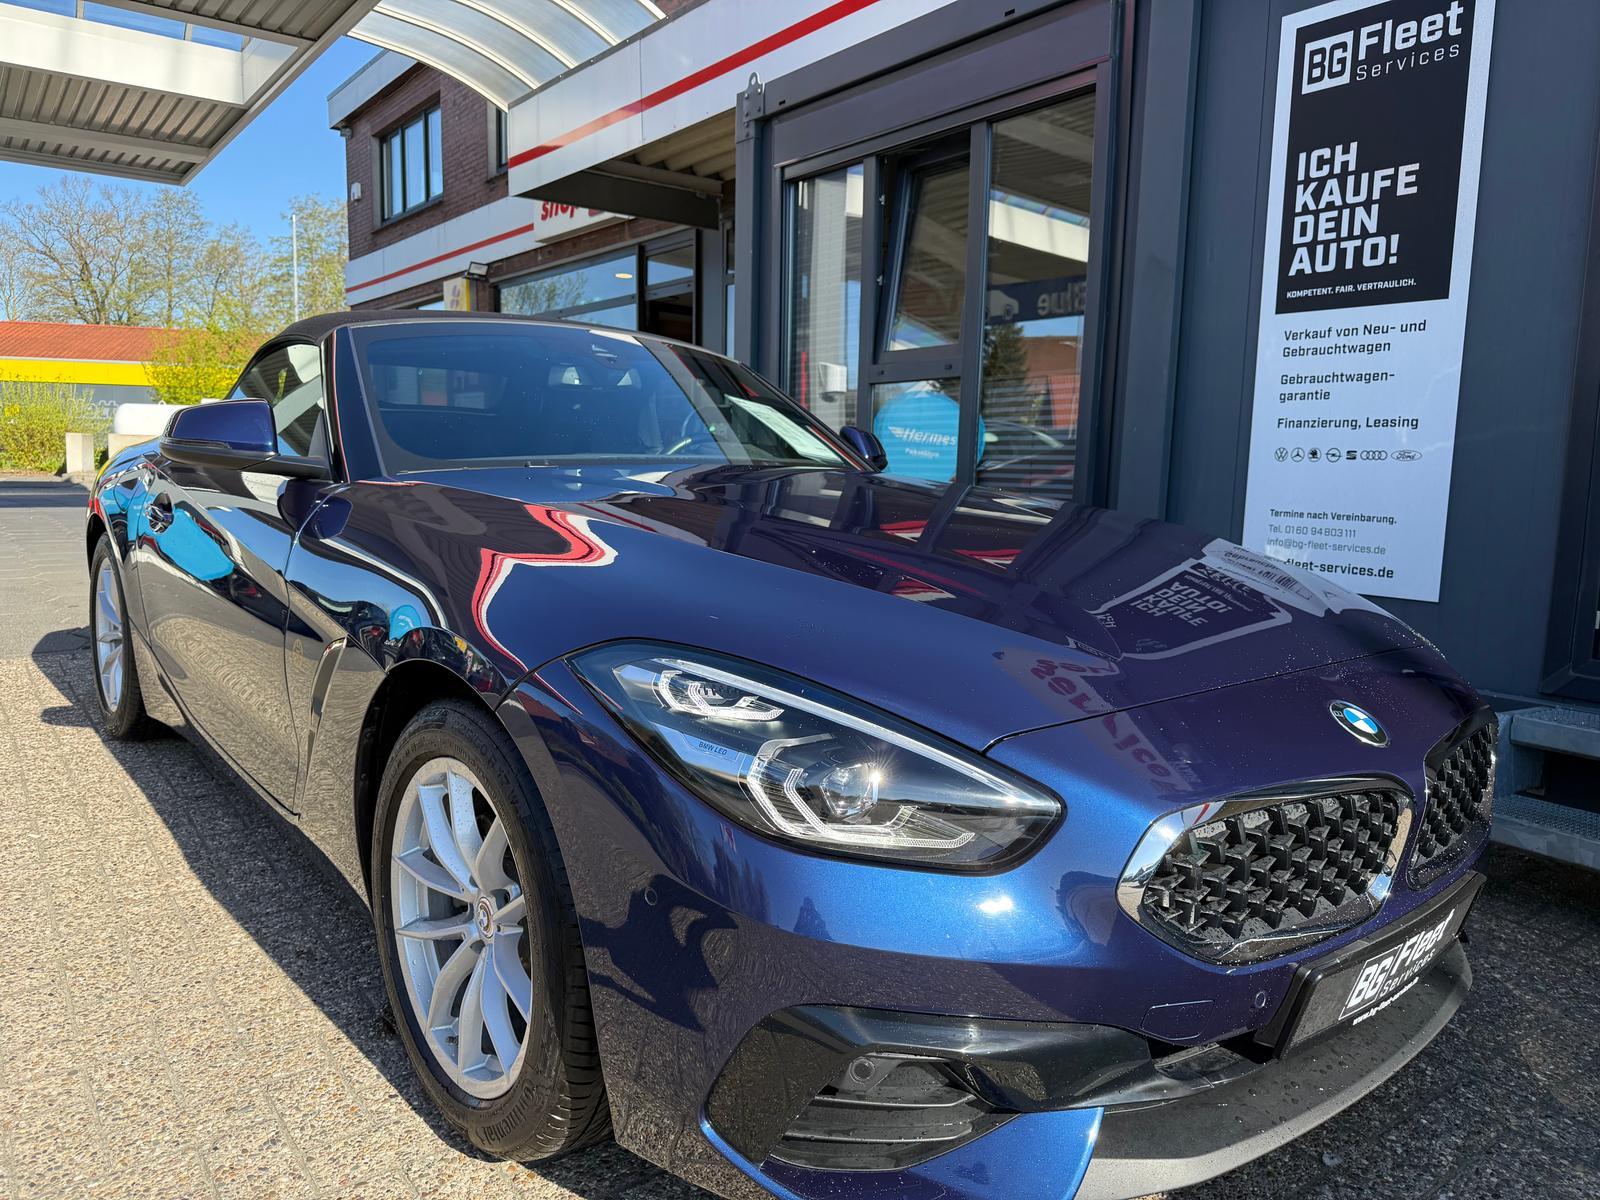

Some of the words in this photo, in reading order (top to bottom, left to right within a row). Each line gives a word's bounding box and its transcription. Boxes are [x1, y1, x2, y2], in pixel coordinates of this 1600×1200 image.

[1307, 41, 1348, 85] BG
[1358, 1, 1464, 60] Fleet
[1356, 44, 1460, 81] Services
[1297, 141, 1358, 182] ICH
[1295, 163, 1420, 213] KAUFE
[1292, 203, 1379, 245] DEIN
[1288, 234, 1399, 277] AUTO!
[1286, 287, 1334, 299] KOMPETENT.
[1335, 284, 1355, 294] FAIR.
[1357, 278, 1417, 292] VERTRAULICH.
[1284, 327, 1332, 340] Verkauf
[1336, 327, 1359, 337] von
[1363, 324, 1396, 336] Neu-
[1400, 319, 1427, 333] und
[1282, 342, 1391, 358] Gebrauchtwagen
[1280, 371, 1396, 385] Gebrauchtwagen-
[1279, 389, 1331, 403] garantie
[1277, 417, 1362, 431] Finanzierung,
[1366, 416, 1419, 430] Leasing
[902, 427, 957, 447] Hermes
[1269, 508, 1305, 519] Termine
[1306, 510, 1329, 520] nach
[1331, 513, 1397, 525] Vereinbarung.
[698, 741, 714, 751] BMW
[714, 746, 728, 755] LED
[1346, 955, 1395, 1009] BG
